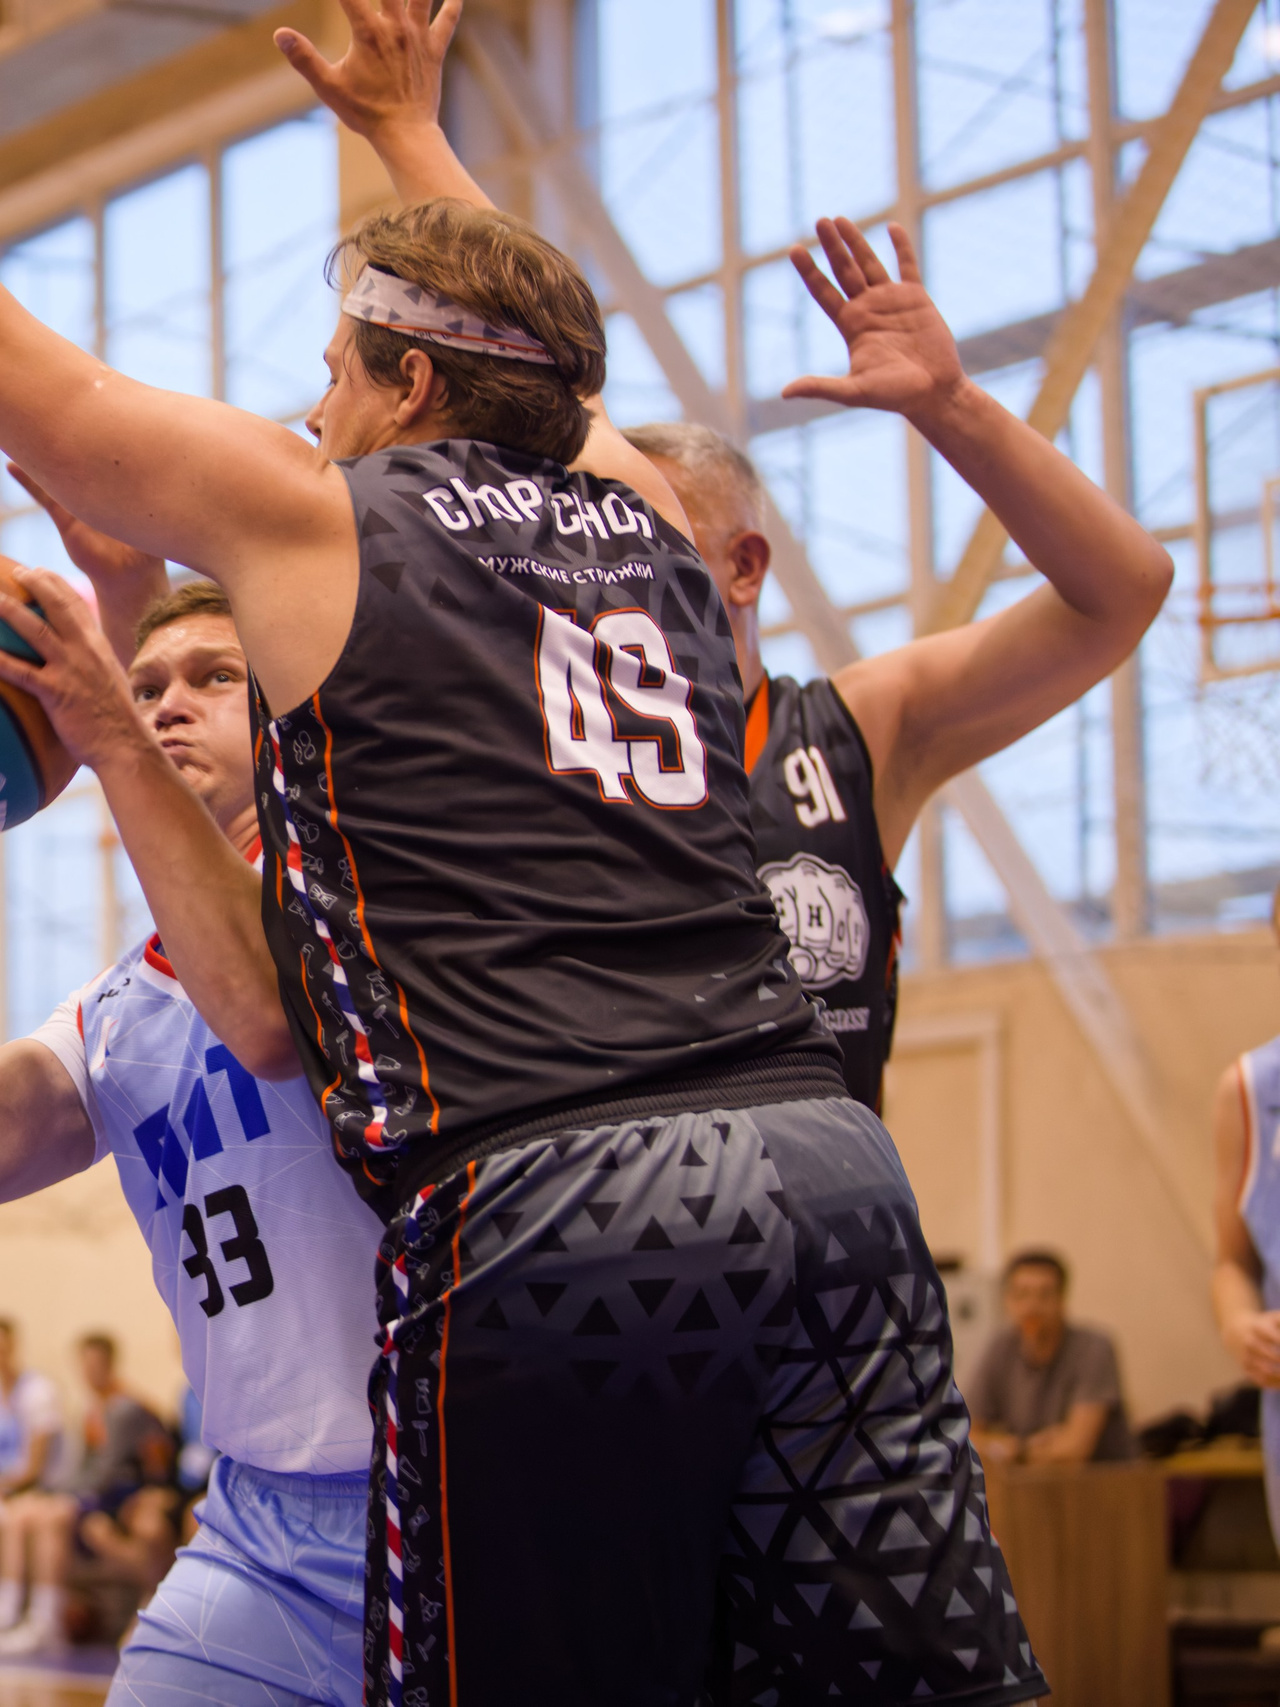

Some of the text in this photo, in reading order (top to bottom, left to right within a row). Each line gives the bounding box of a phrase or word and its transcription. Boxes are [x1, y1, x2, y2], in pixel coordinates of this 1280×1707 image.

[572, 561, 654, 585] СТРИЖКИ
[534, 602, 709, 810] 49
[783, 745, 848, 828] 91
[181, 1184, 274, 1318] 33
